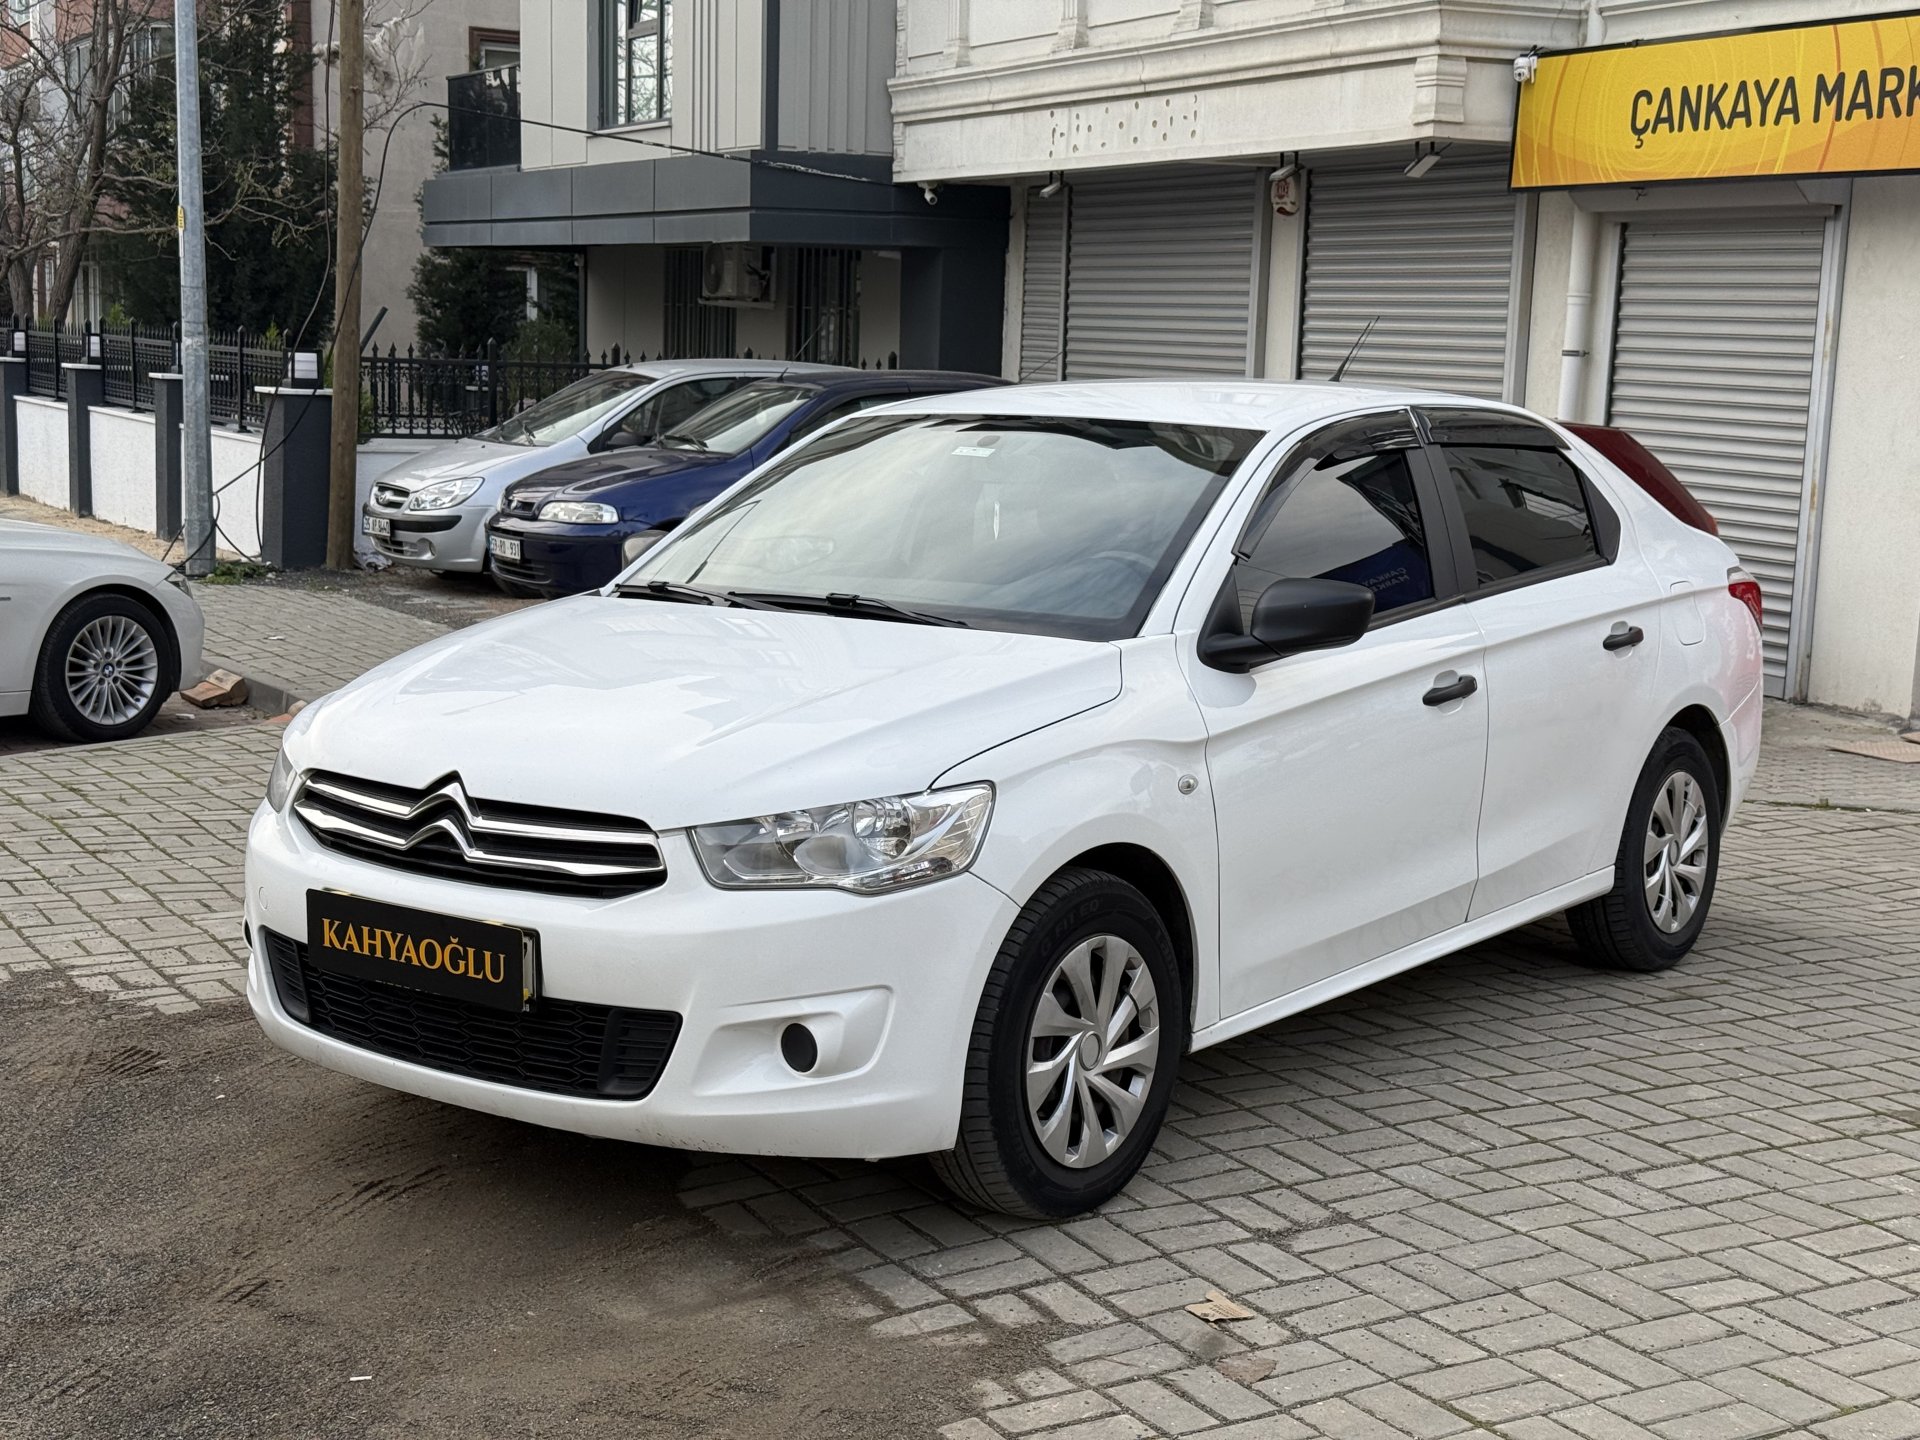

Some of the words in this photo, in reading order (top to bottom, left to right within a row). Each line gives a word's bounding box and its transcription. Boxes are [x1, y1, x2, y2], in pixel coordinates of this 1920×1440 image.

[1630, 76, 1800, 149] ÇANKAYA
[1812, 65, 1920, 124] MARK
[509, 541, 520, 557] 931
[321, 917, 506, 984] KAHYAOĞLU
